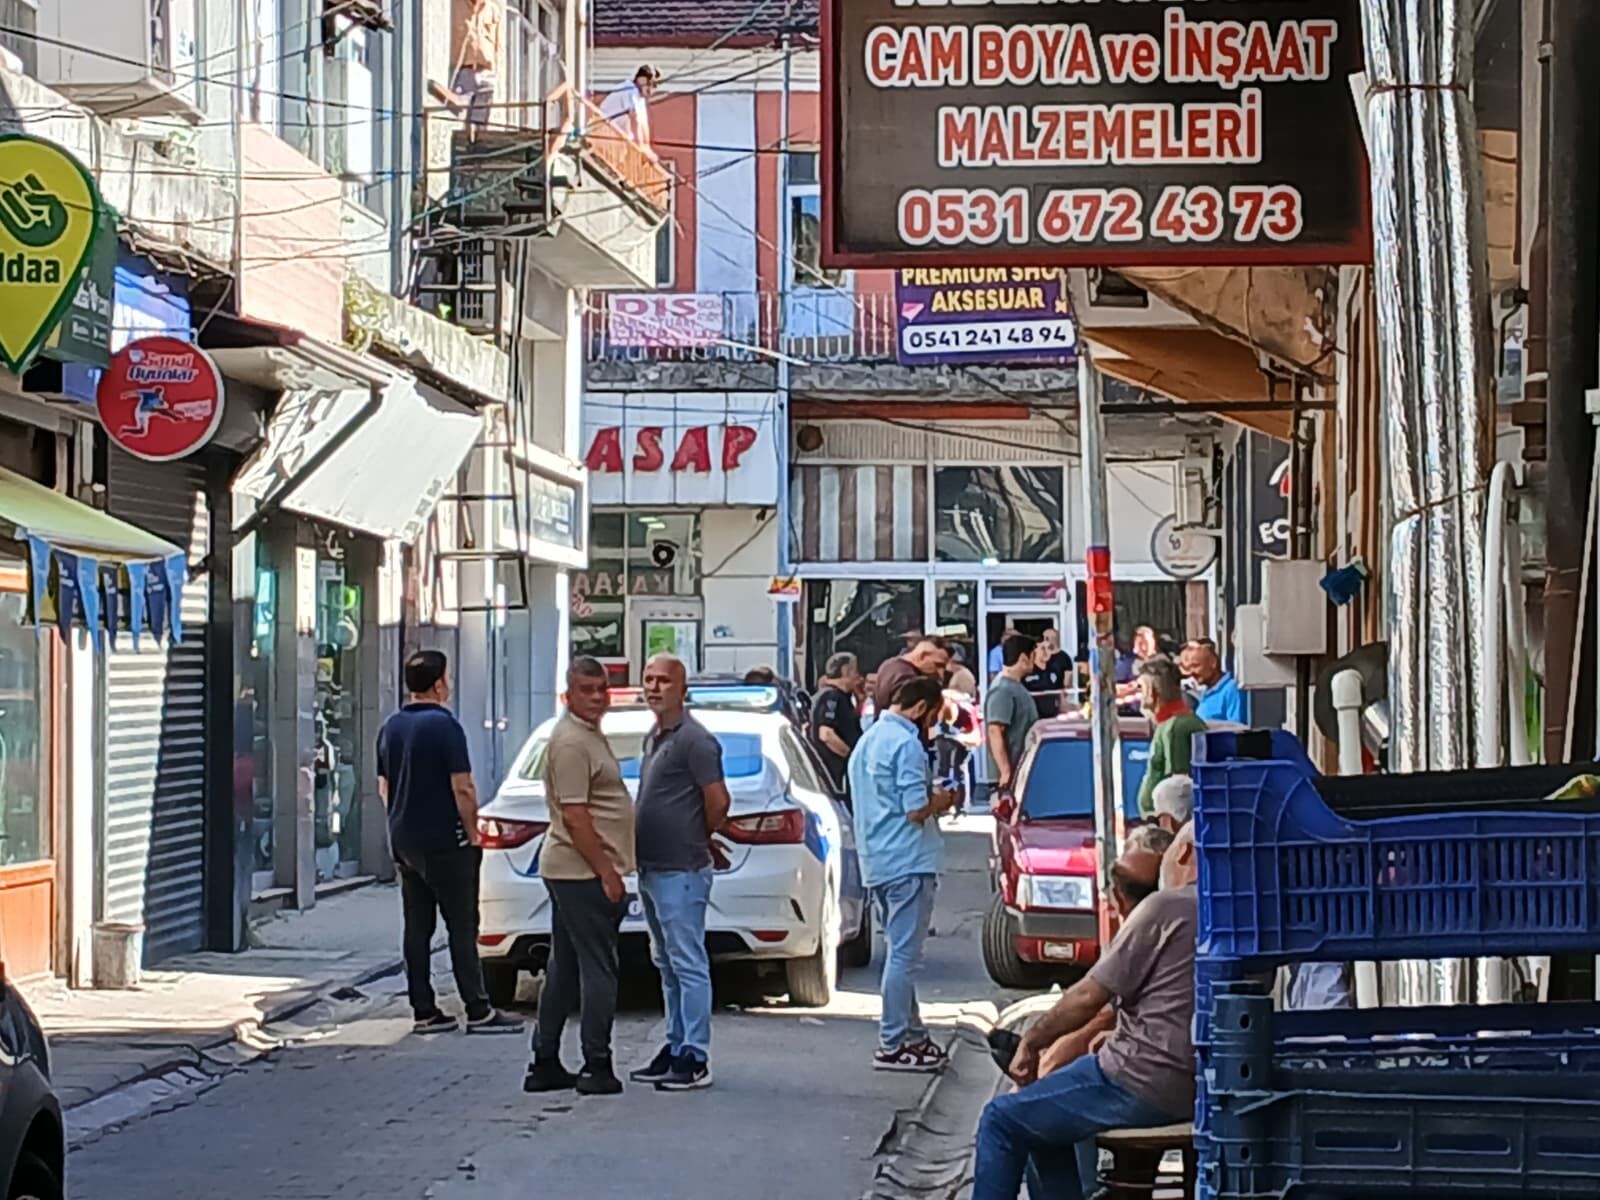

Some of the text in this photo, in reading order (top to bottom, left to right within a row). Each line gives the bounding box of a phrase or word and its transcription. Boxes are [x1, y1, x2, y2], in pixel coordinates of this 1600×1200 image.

[866, 7, 1337, 89] CAM BOYA ve İNŞAAT
[938, 88, 1262, 167] MALZEMELERİ
[898, 185, 1302, 246] 0531 672 43 73
[902, 267, 1008, 286] PREMIUM
[931, 287, 1046, 313] AKSESUAR
[909, 326, 1067, 348] 0541 241 48 94
